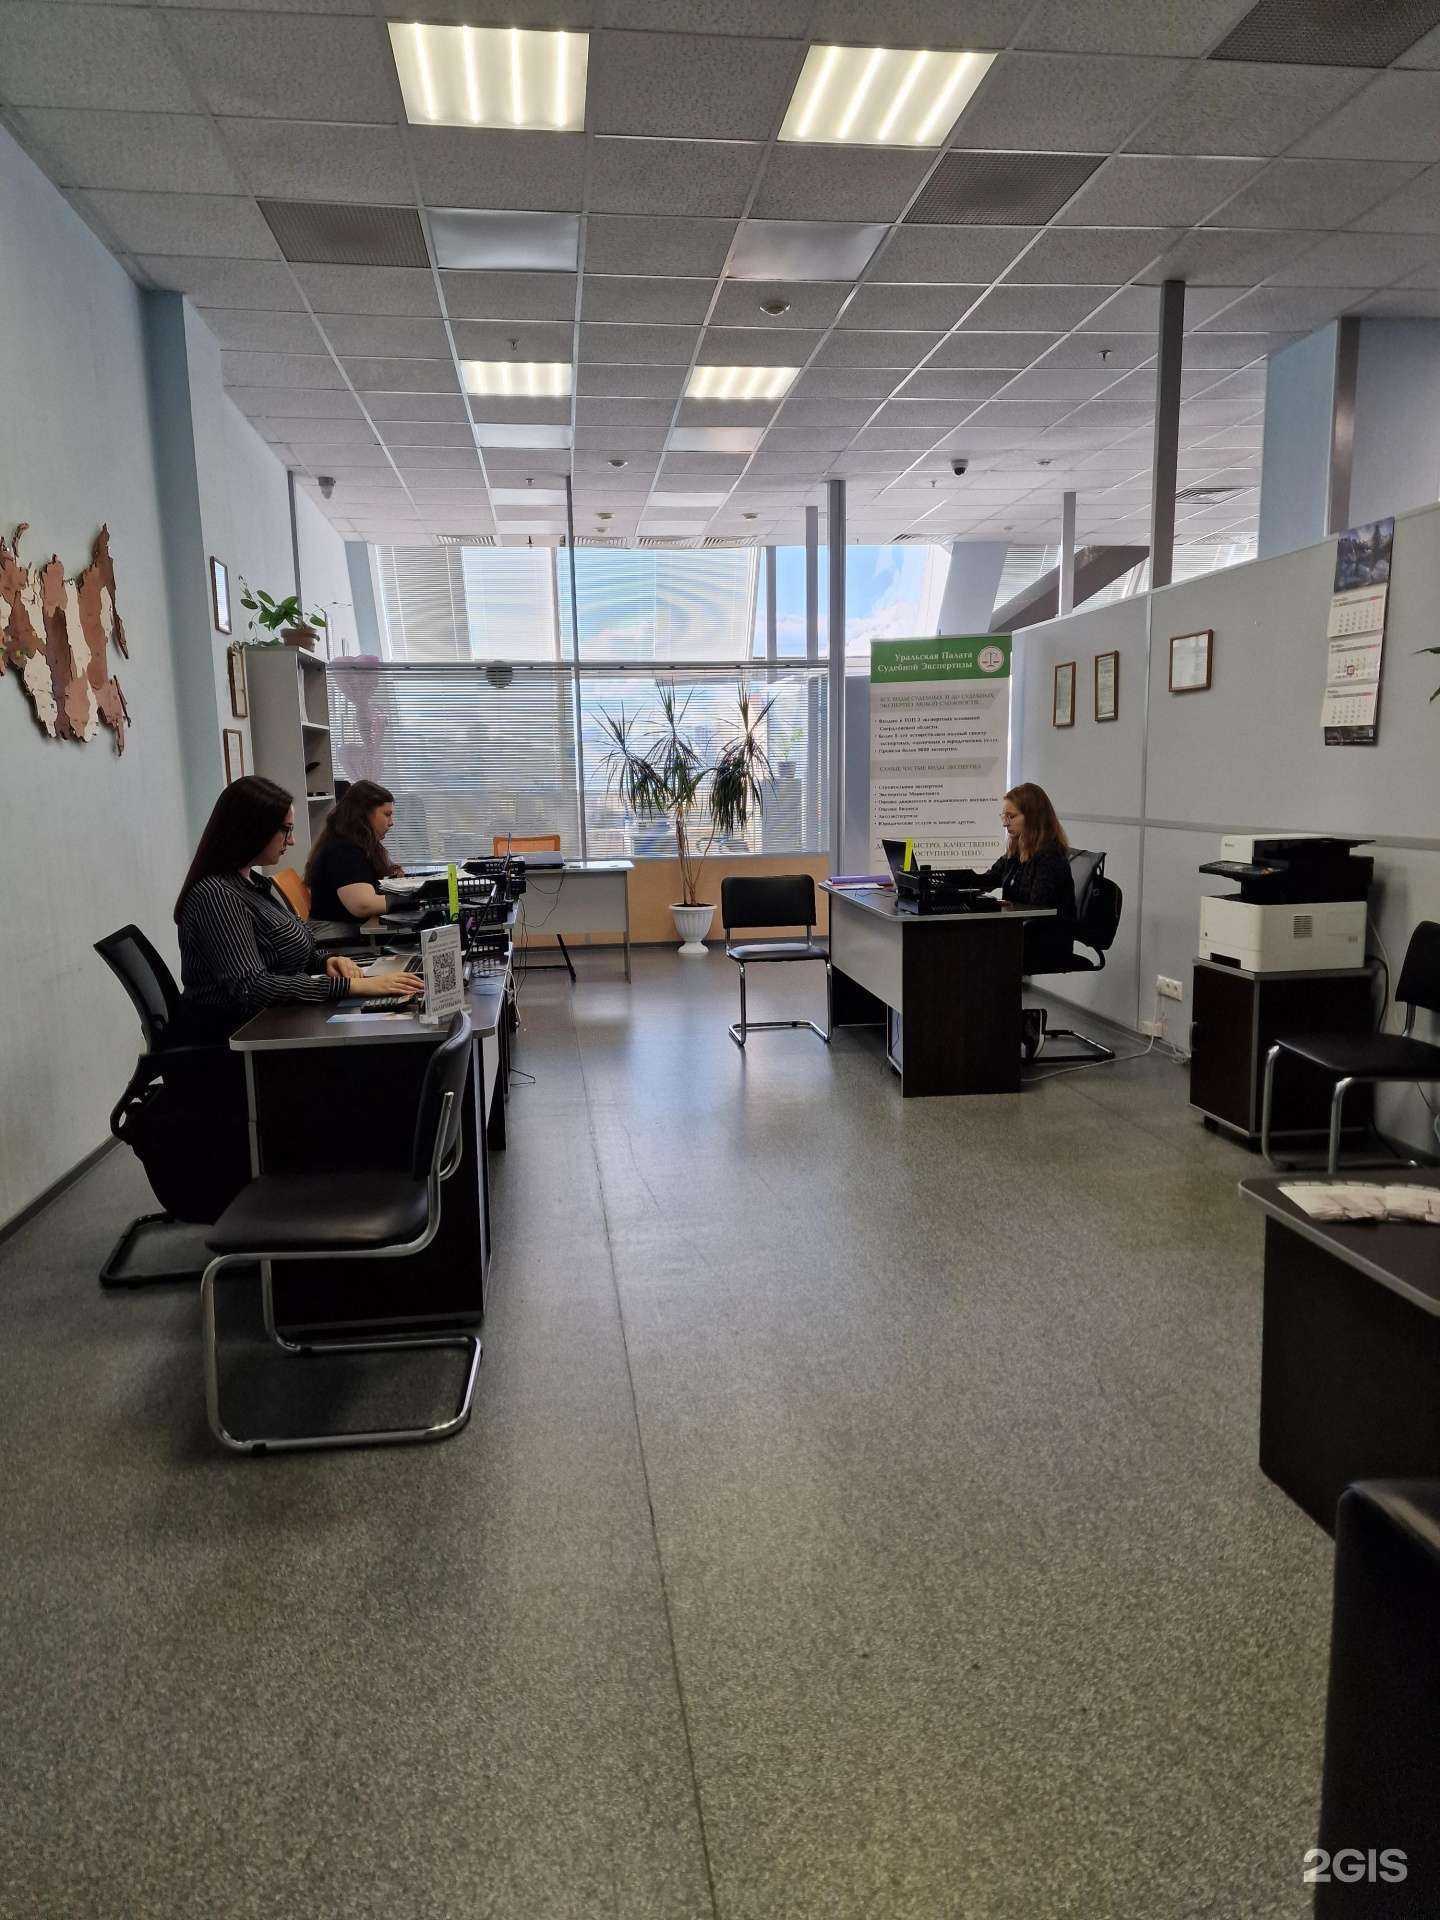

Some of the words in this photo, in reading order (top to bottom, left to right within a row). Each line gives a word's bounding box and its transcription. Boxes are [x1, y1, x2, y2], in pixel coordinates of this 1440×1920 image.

[895, 653, 938, 663] Уральская
[942, 651, 972, 660] Палата
[877, 663, 918, 673] Судебной
[921, 662, 973, 671] Экспертизы
[912, 841, 941, 849] ЫСТРО,
[914, 849, 959, 858] ОСТУПНУЮ
